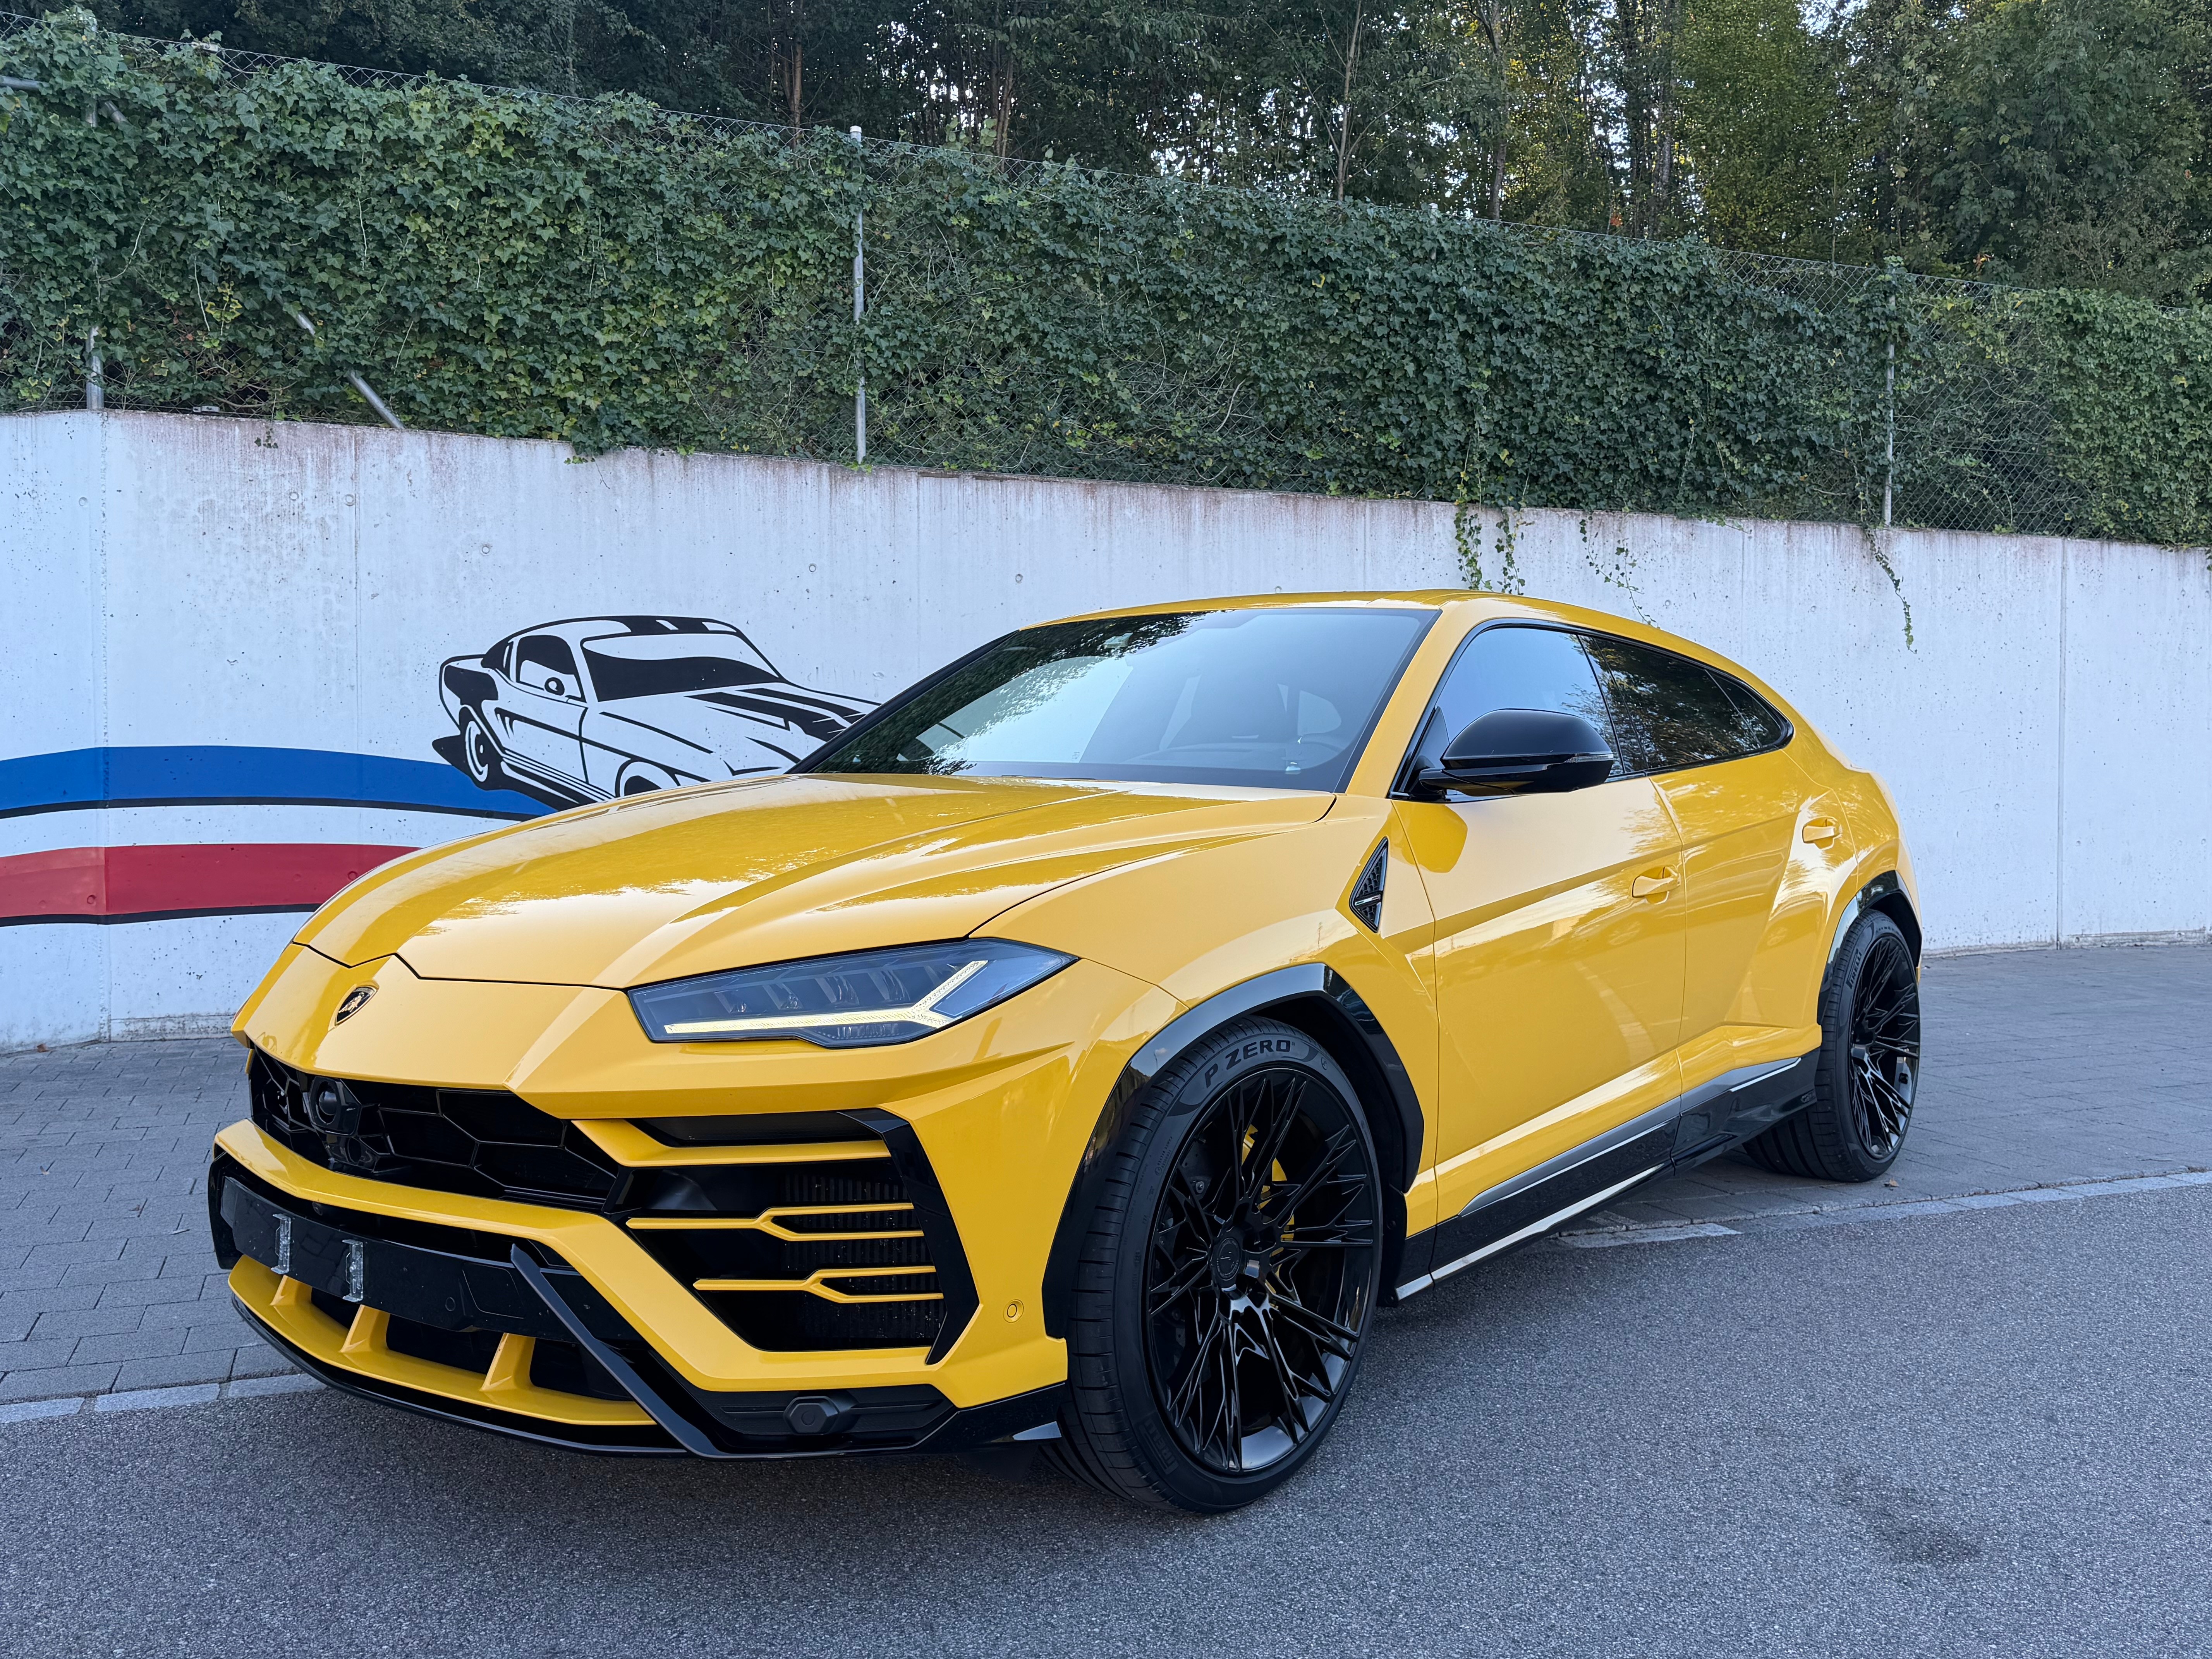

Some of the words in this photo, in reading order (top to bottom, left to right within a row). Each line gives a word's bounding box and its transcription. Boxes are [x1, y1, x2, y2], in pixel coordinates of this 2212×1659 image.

[1846, 948, 1862, 989] PIRELLI
[1204, 1063, 1218, 1089] P
[1225, 1039, 1291, 1070] ZERO
[1137, 1419, 1180, 1475] PIRELLI
